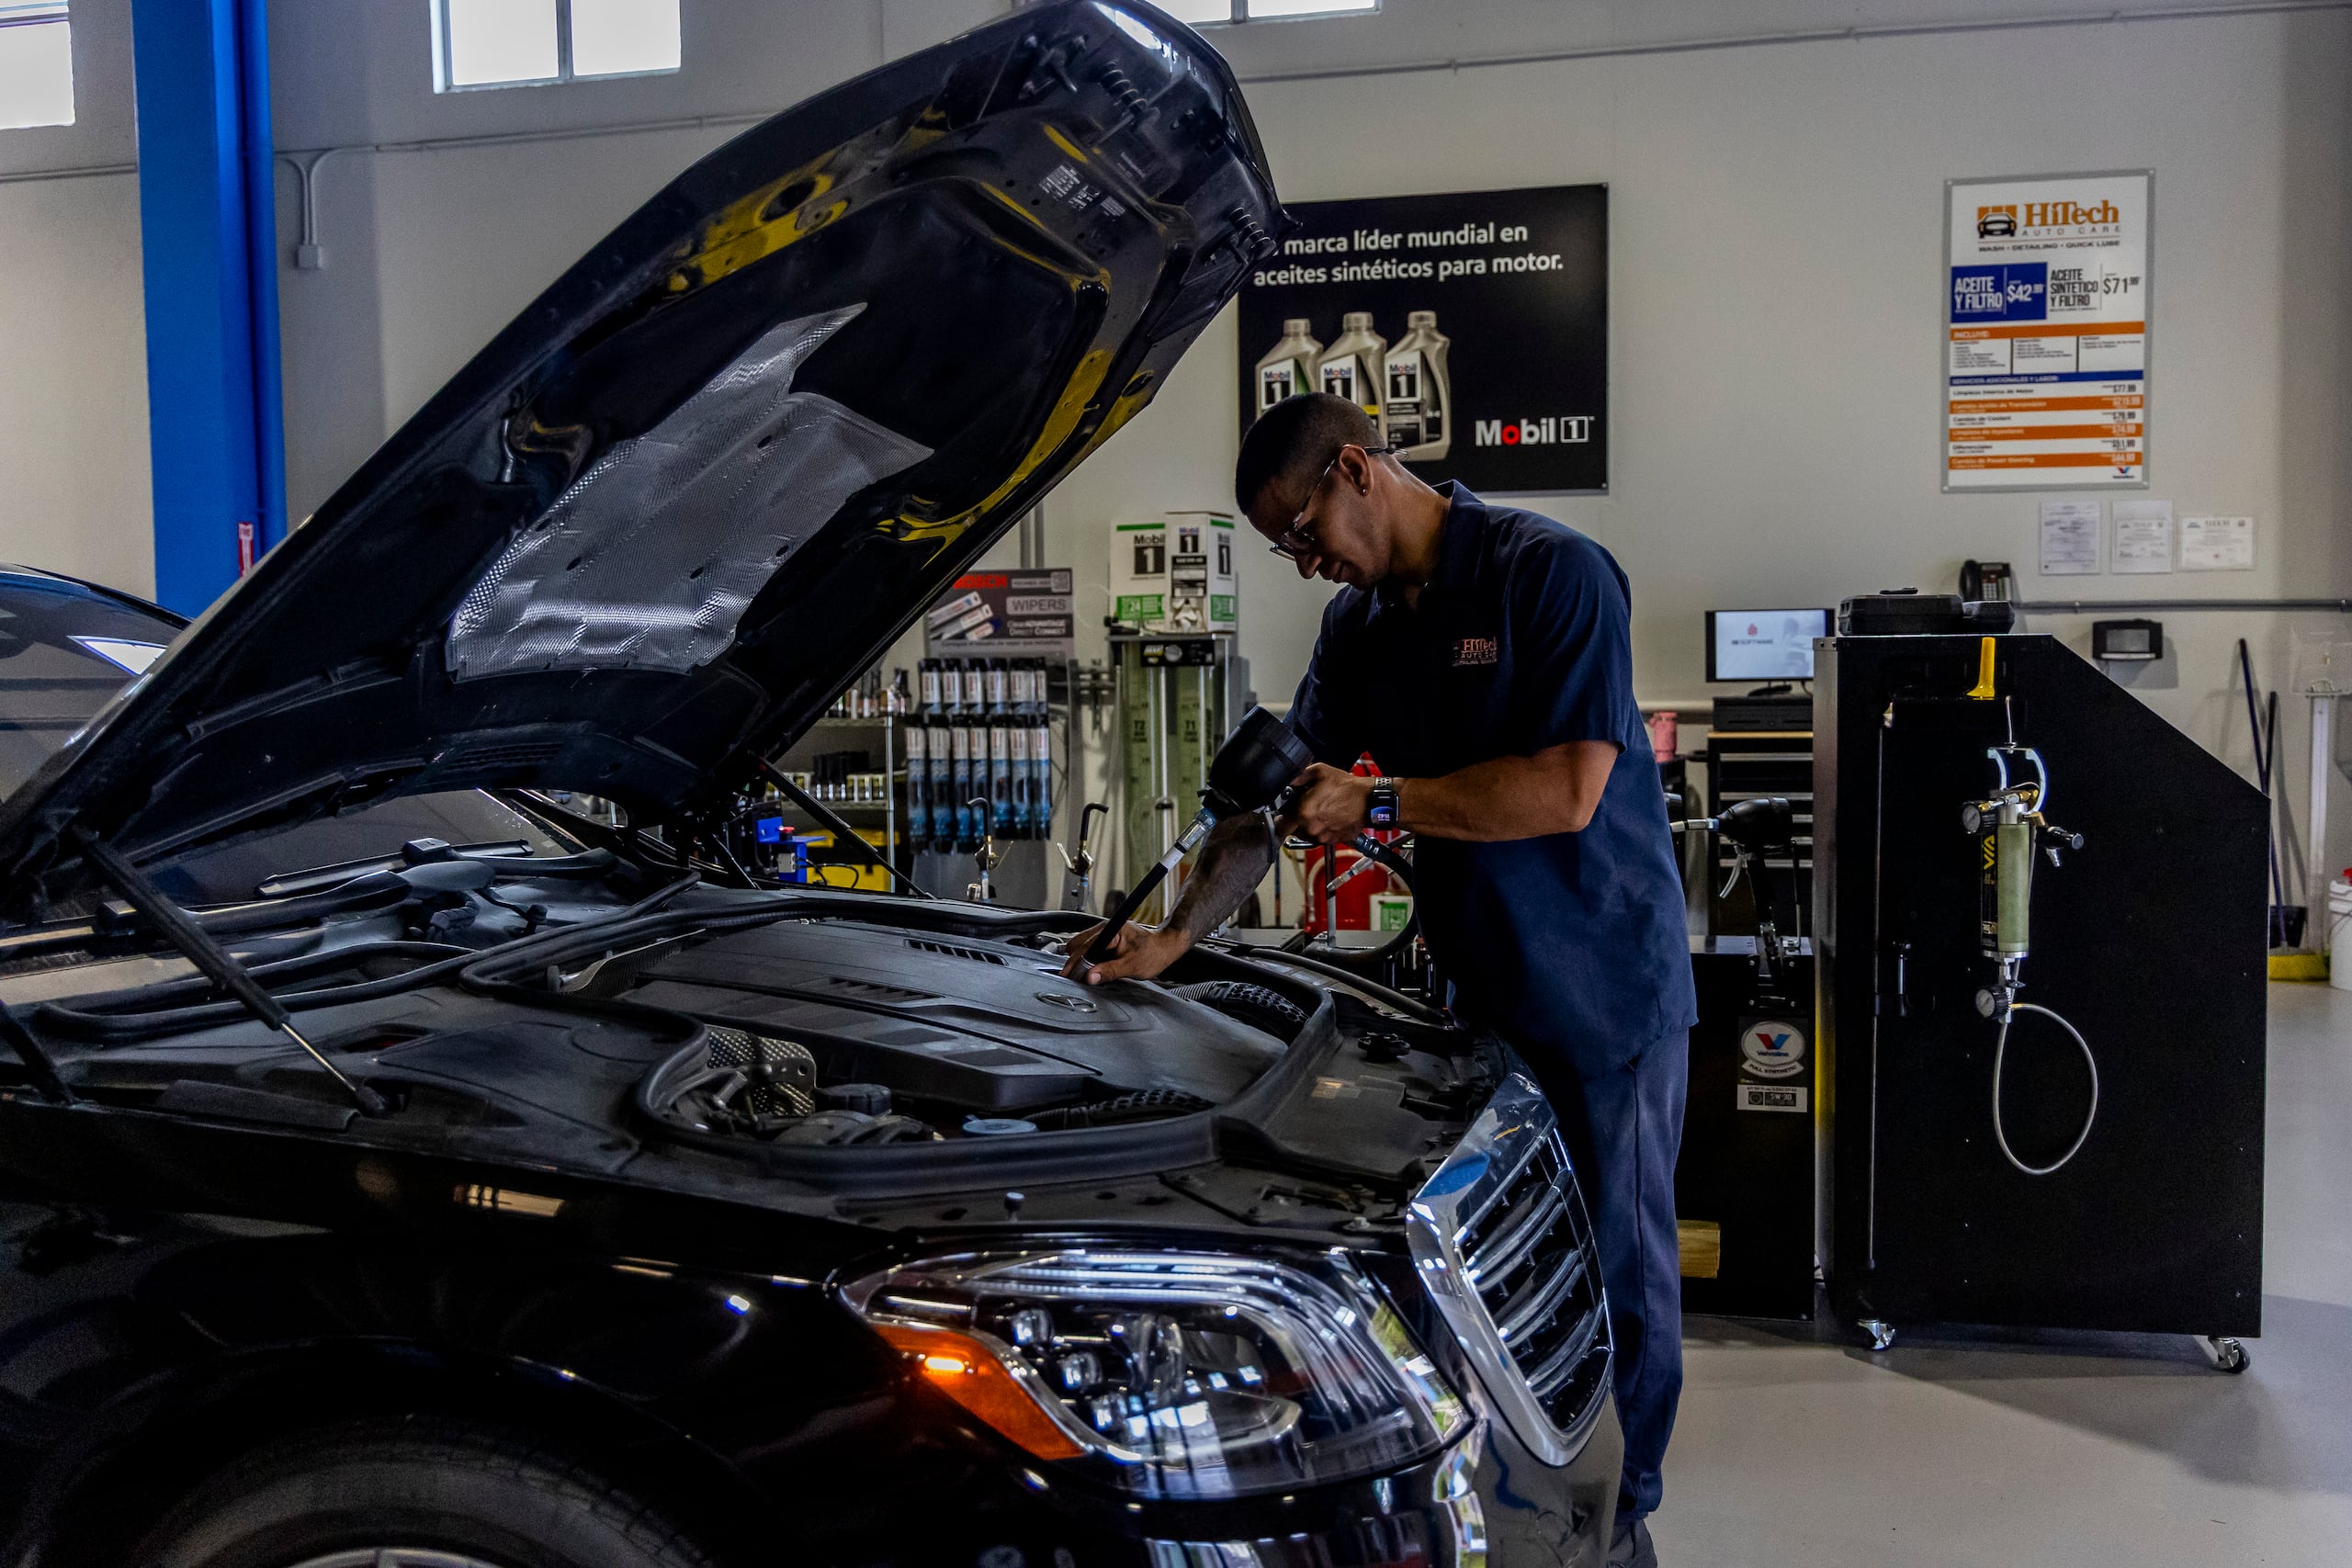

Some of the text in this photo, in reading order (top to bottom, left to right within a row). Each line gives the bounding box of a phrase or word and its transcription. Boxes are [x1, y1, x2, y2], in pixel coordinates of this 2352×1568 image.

[2023, 199, 2120, 227] HiTech
[1283, 221, 1529, 255] marca líder mundial en
[2021, 225, 2121, 237] AUTO CARE
[1254, 253, 1564, 288] aceites sintéticos para motor.
[2050, 268, 2084, 282] ACEITE
[1954, 276, 1996, 294] ACEITE
[1954, 292, 2004, 310] Y FILTRO
[2050, 294, 2092, 308] Y FILTRO
[1264, 371, 1292, 381] Mobil
[1323, 367, 1352, 378] Mobil
[1388, 364, 1418, 375] Mobil
[1396, 375, 1408, 398] 1
[1475, 417, 1556, 446] Mobil
[1134, 533, 1166, 545] Mobil
[1143, 547, 1155, 573] 1
[1012, 598, 1067, 612] WIPERS
